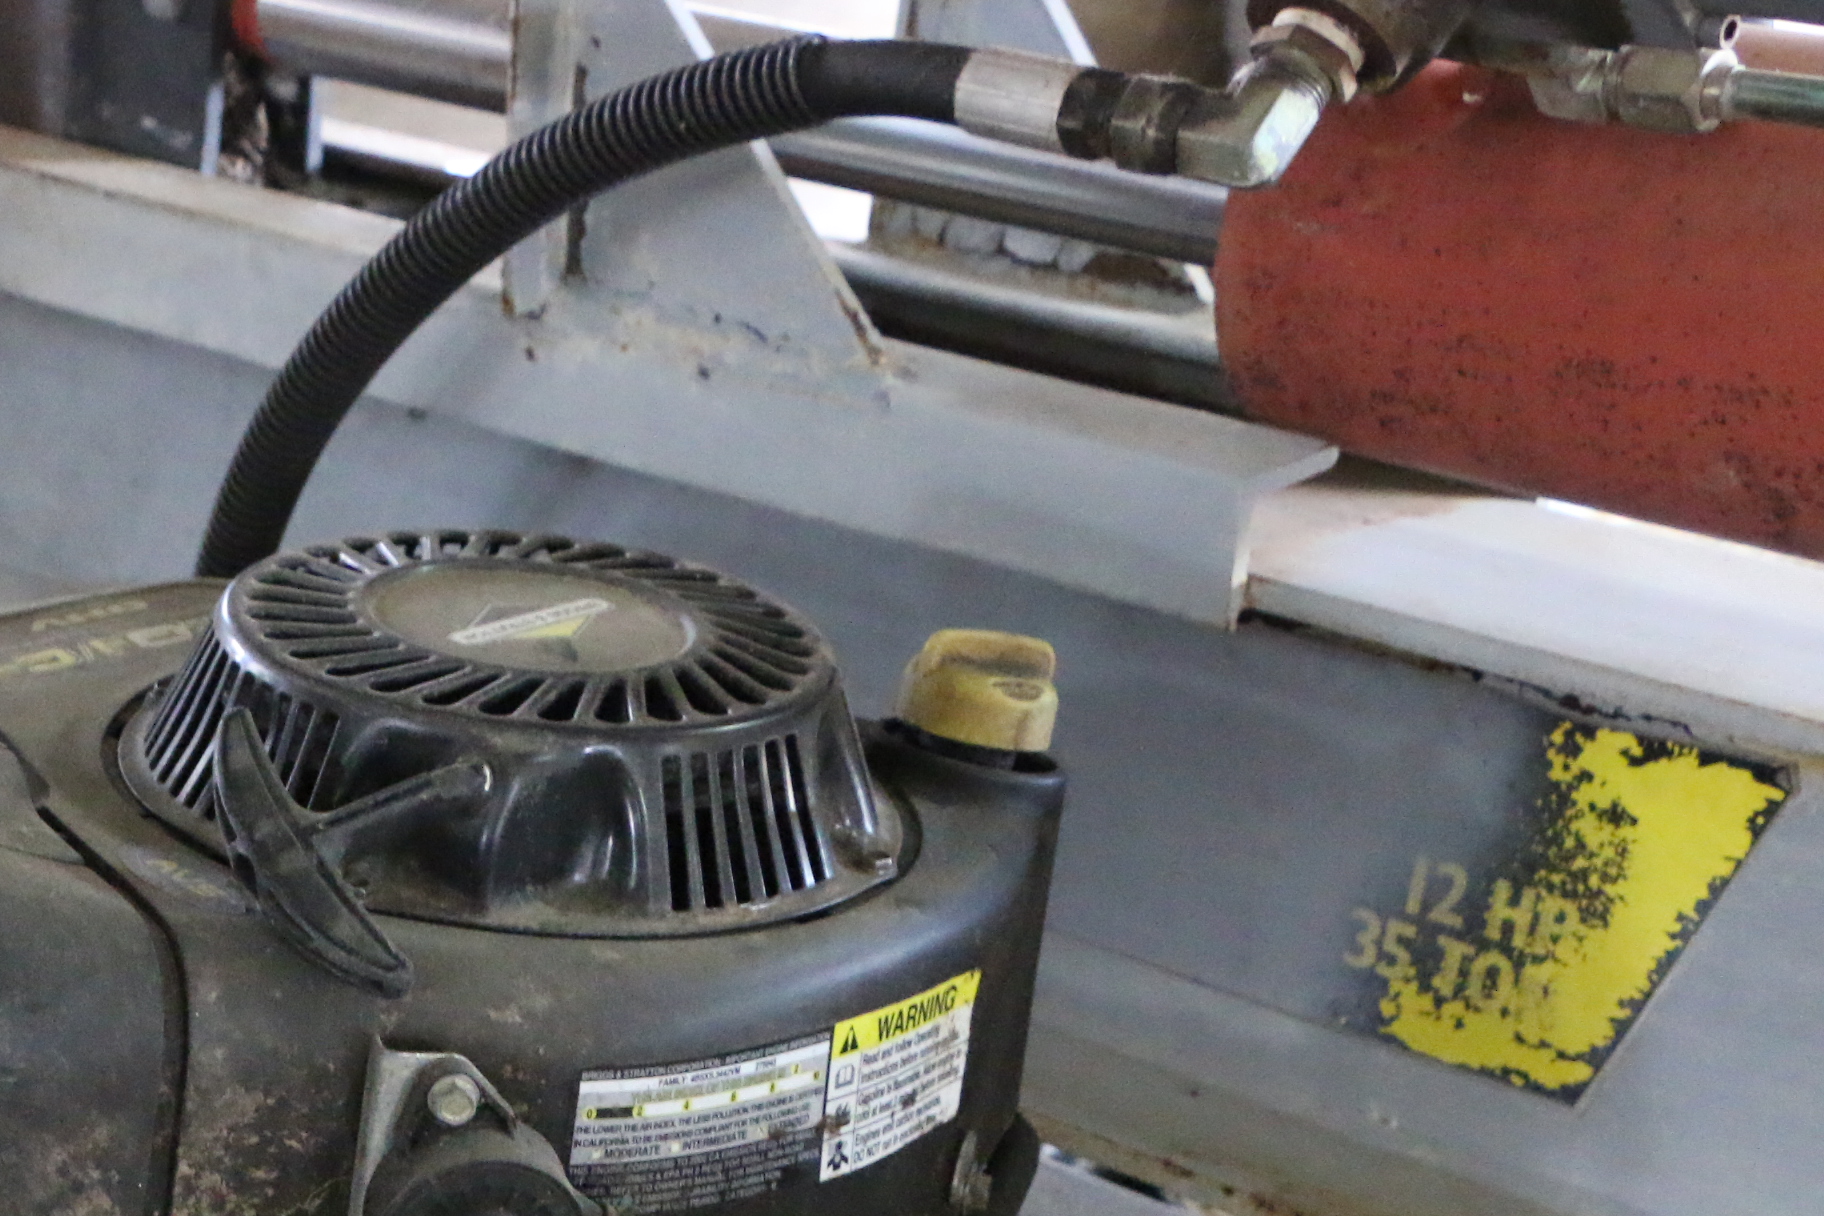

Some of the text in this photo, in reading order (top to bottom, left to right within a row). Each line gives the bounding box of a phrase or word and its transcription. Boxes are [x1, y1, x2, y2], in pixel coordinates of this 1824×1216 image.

[1405, 855, 1579, 955] 12 HP
[1342, 907, 1417, 982] 35
[878, 985, 957, 1042] WARNING
[587, 1109, 593, 1119] 0
[684, 1100, 689, 1111] 4
[604, 1144, 660, 1159] MODERATE
[683, 1128, 747, 1151] INTERMEDIATE
[854, 1148, 865, 1163] DO
[866, 1141, 881, 1157] NOT
